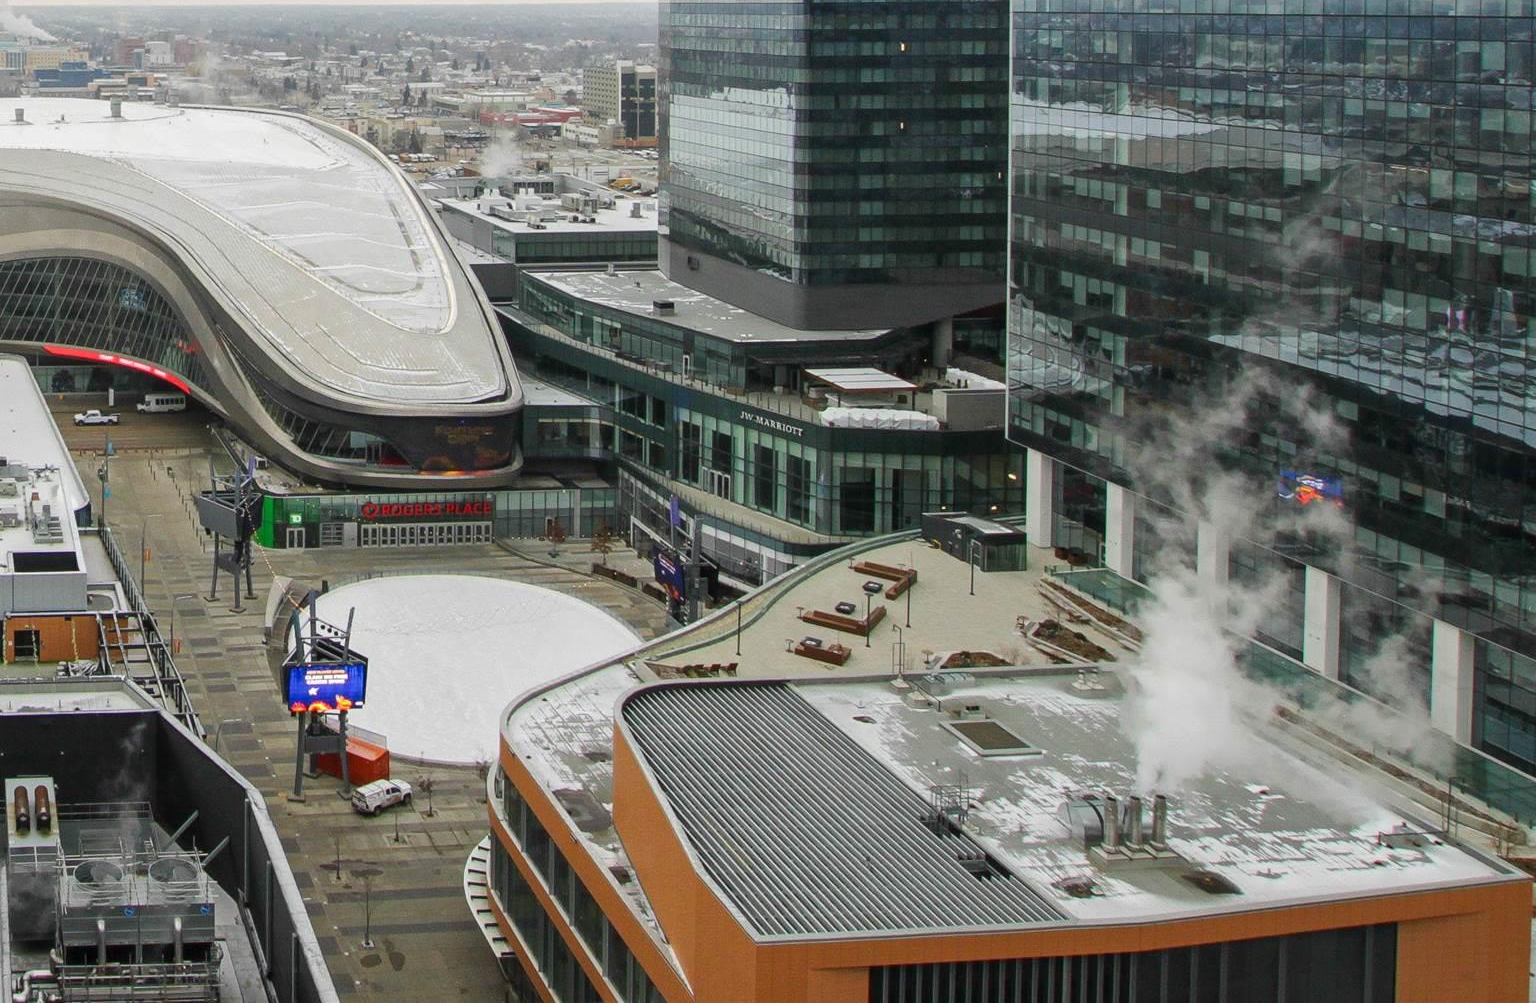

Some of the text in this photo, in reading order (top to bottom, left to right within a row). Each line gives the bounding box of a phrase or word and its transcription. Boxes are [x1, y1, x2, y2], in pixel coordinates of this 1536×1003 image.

[740, 411, 804, 437] JW MARRIOTT
[381, 501, 492, 517] ROGERS PLACE
